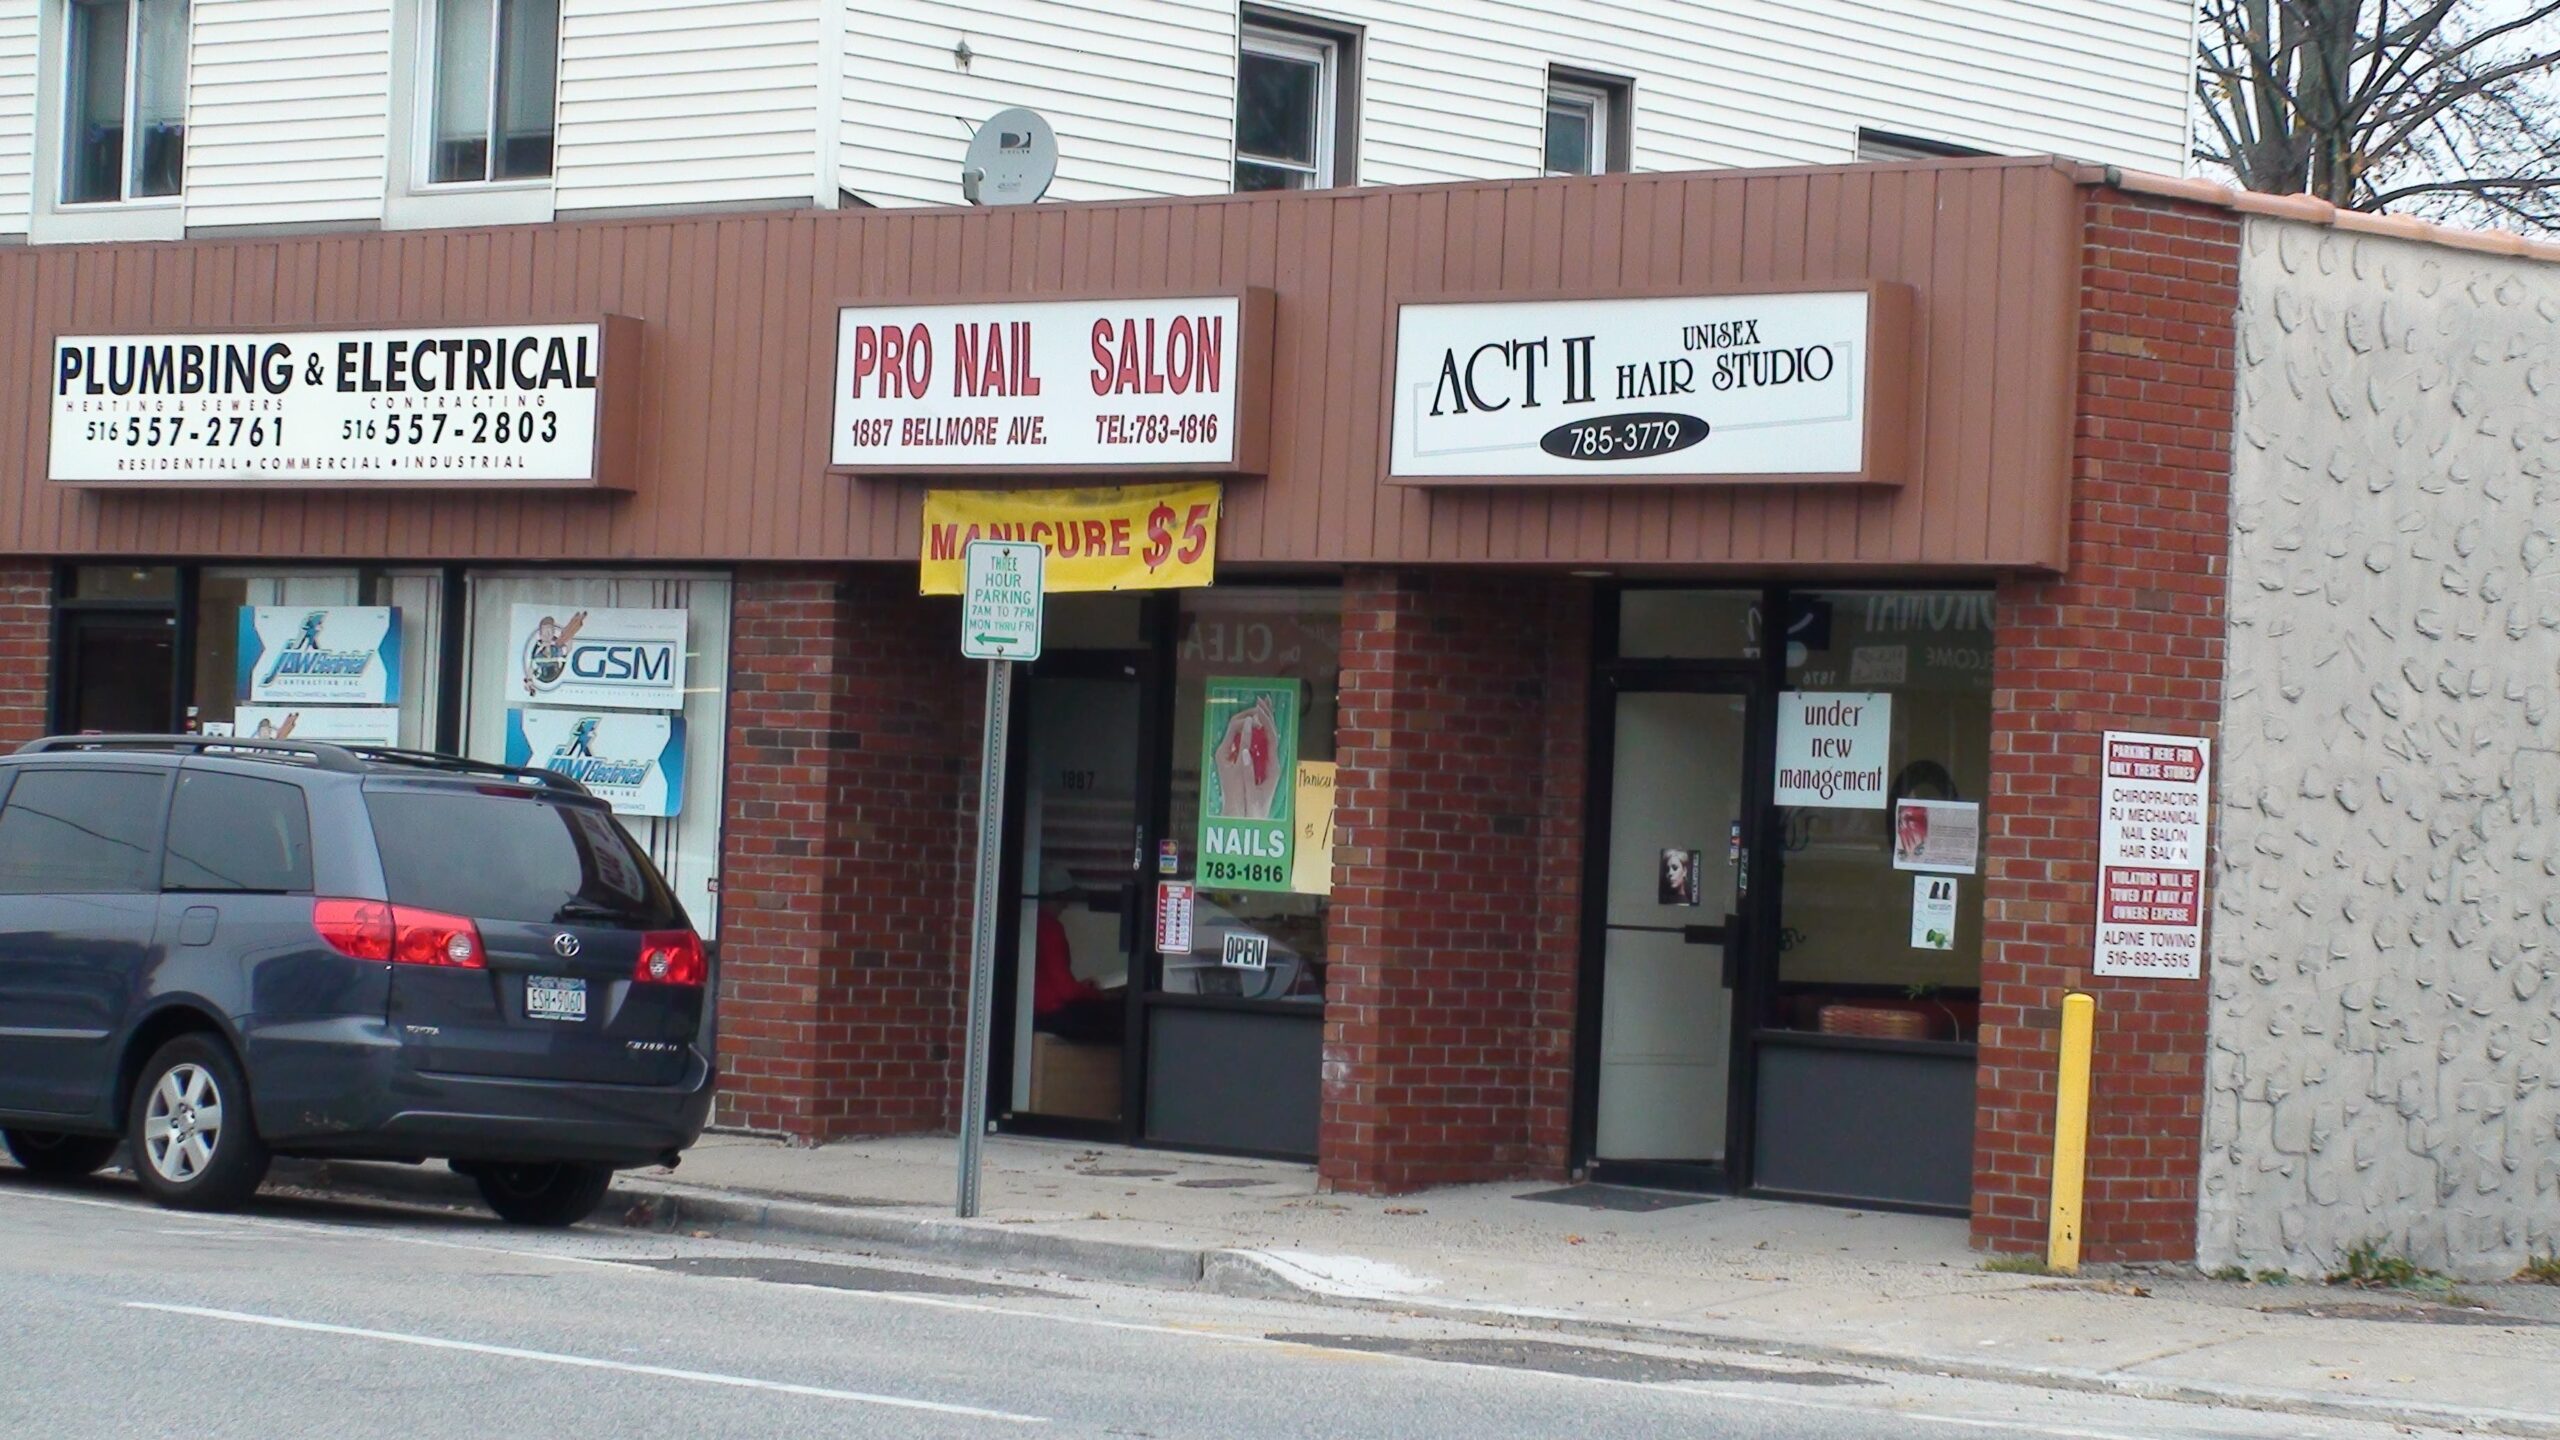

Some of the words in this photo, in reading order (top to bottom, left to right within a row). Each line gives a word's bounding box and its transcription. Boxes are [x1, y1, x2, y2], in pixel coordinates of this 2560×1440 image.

[1682, 319, 1761, 352] UNISEX
[59, 342, 294, 397] PLUMBING
[304, 352, 325, 387] &
[336, 336, 598, 394] ELECTRICAL
[852, 322, 933, 400] PRO
[954, 320, 1041, 398] NAIL
[1090, 314, 1223, 397] SALON
[1429, 335, 1549, 417] ACT
[1615, 357, 1697, 401] HAIR
[1711, 343, 1834, 392] STUDIO
[65, 399, 165, 413] HEATING
[200, 398, 284, 412] SEWERS
[370, 394, 547, 409] CONTRACTING
[86, 420, 119, 441] 516
[126, 416, 284, 447] 557-2761
[342, 418, 376, 440] 516
[385, 411, 558, 446] 557-2803
[851, 418, 893, 448] 1887
[901, 416, 997, 446] BELLMORE
[1007, 415, 1048, 446] AVE.
[1096, 413, 1218, 445] TEL:783-1816
[1569, 420, 1680, 457] 785-3779
[117, 457, 238, 472] RESIDENTIAL
[259, 456, 381, 471] COMMERCIAL
[405, 455, 526, 470] INDUSTRIAL
[1142, 501, 1211, 574] $5
[991, 556, 1017, 572] THREE
[985, 572, 1022, 588] HOUR
[975, 588, 1032, 605] PARKING
[972, 605, 992, 616] 7AM
[997, 606, 1010, 617] TO
[1014, 606, 1035, 618] 7PM
[969, 619, 991, 630] MON
[994, 621, 1017, 632] THRU
[1018, 621, 1035, 632] FRI
[571, 645, 671, 681] GSM
[1804, 699, 1864, 728] under
[1811, 737, 1853, 759] new
[2112, 744, 2151, 760] PARKING
[2152, 747, 2176, 761] HERE
[2133, 763, 2162, 778] THESE
[2162, 765, 2197, 780] STORES
[1779, 765, 1882, 801] management
[2112, 788, 2199, 806] CHIROPRACTOR
[2109, 807, 2124, 821] RJ
[2128, 808, 2200, 825] MECHANICAL
[1204, 826, 1285, 857] NAILS
[2121, 825, 2146, 840] NAIL
[2150, 827, 2188, 842] SALON
[2119, 845, 2146, 859] HAIR
[1205, 860, 1284, 883] 783-1816
[2103, 930, 2145, 947] ALPINE
[2150, 932, 2196, 948] TOWING
[1226, 936, 1265, 967] OPEN
